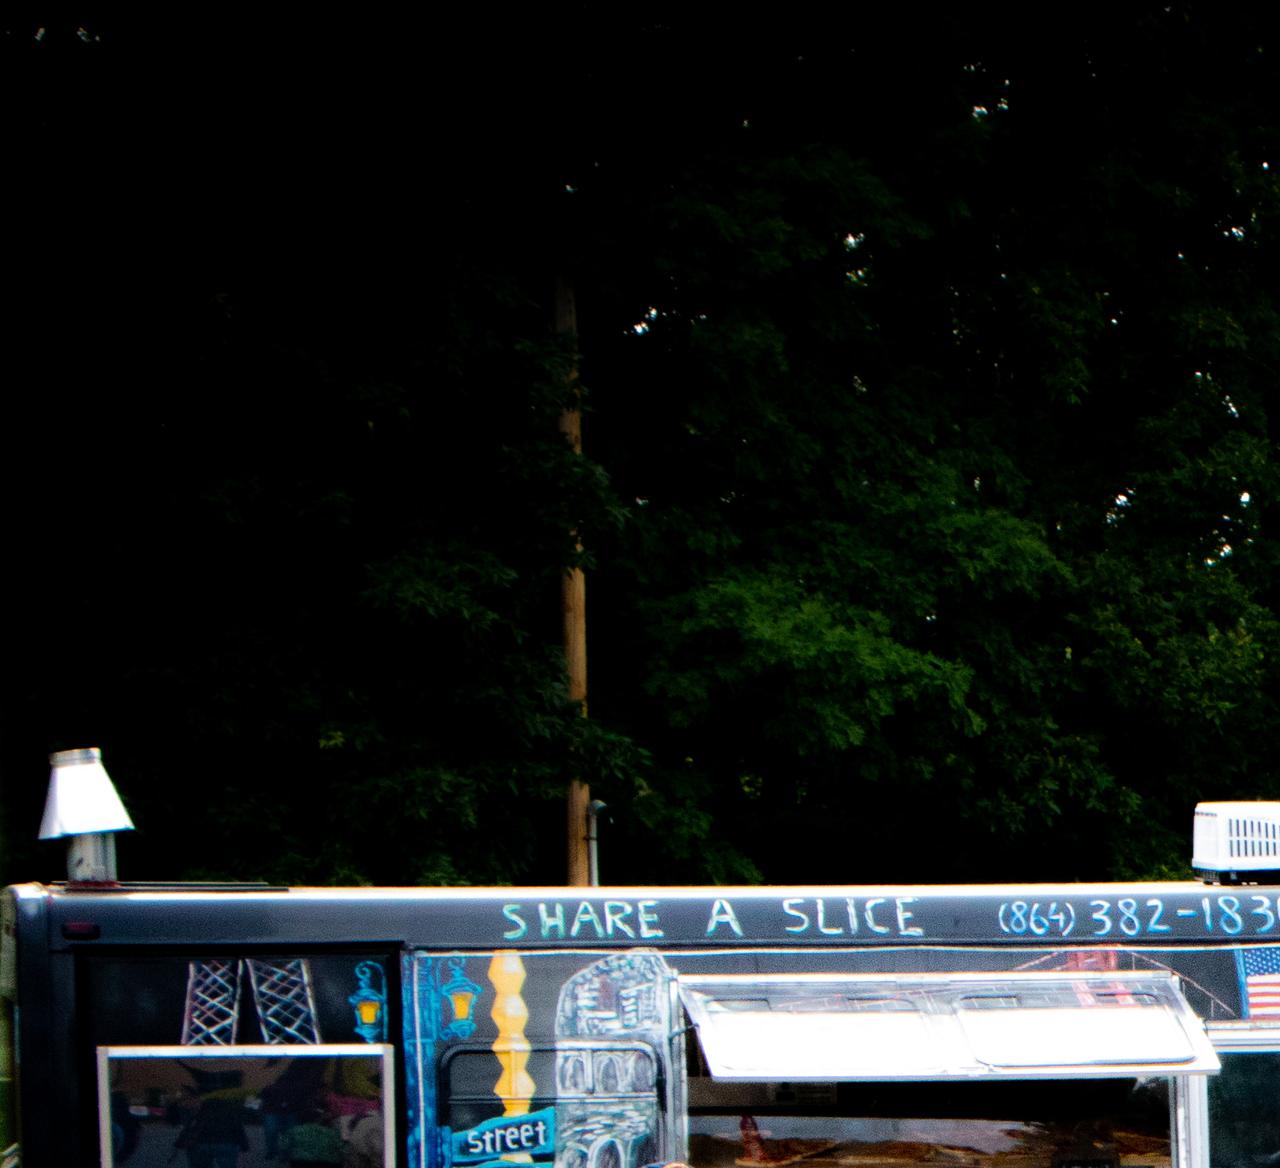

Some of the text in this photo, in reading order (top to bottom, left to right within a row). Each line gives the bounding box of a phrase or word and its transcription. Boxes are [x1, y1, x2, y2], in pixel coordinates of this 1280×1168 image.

[503, 900, 665, 939] SHARE
[707, 899, 743, 938] A
[783, 897, 924, 936] SLICE
[998, 901, 1075, 936] (864)
[466, 1121, 546, 1154] Street
